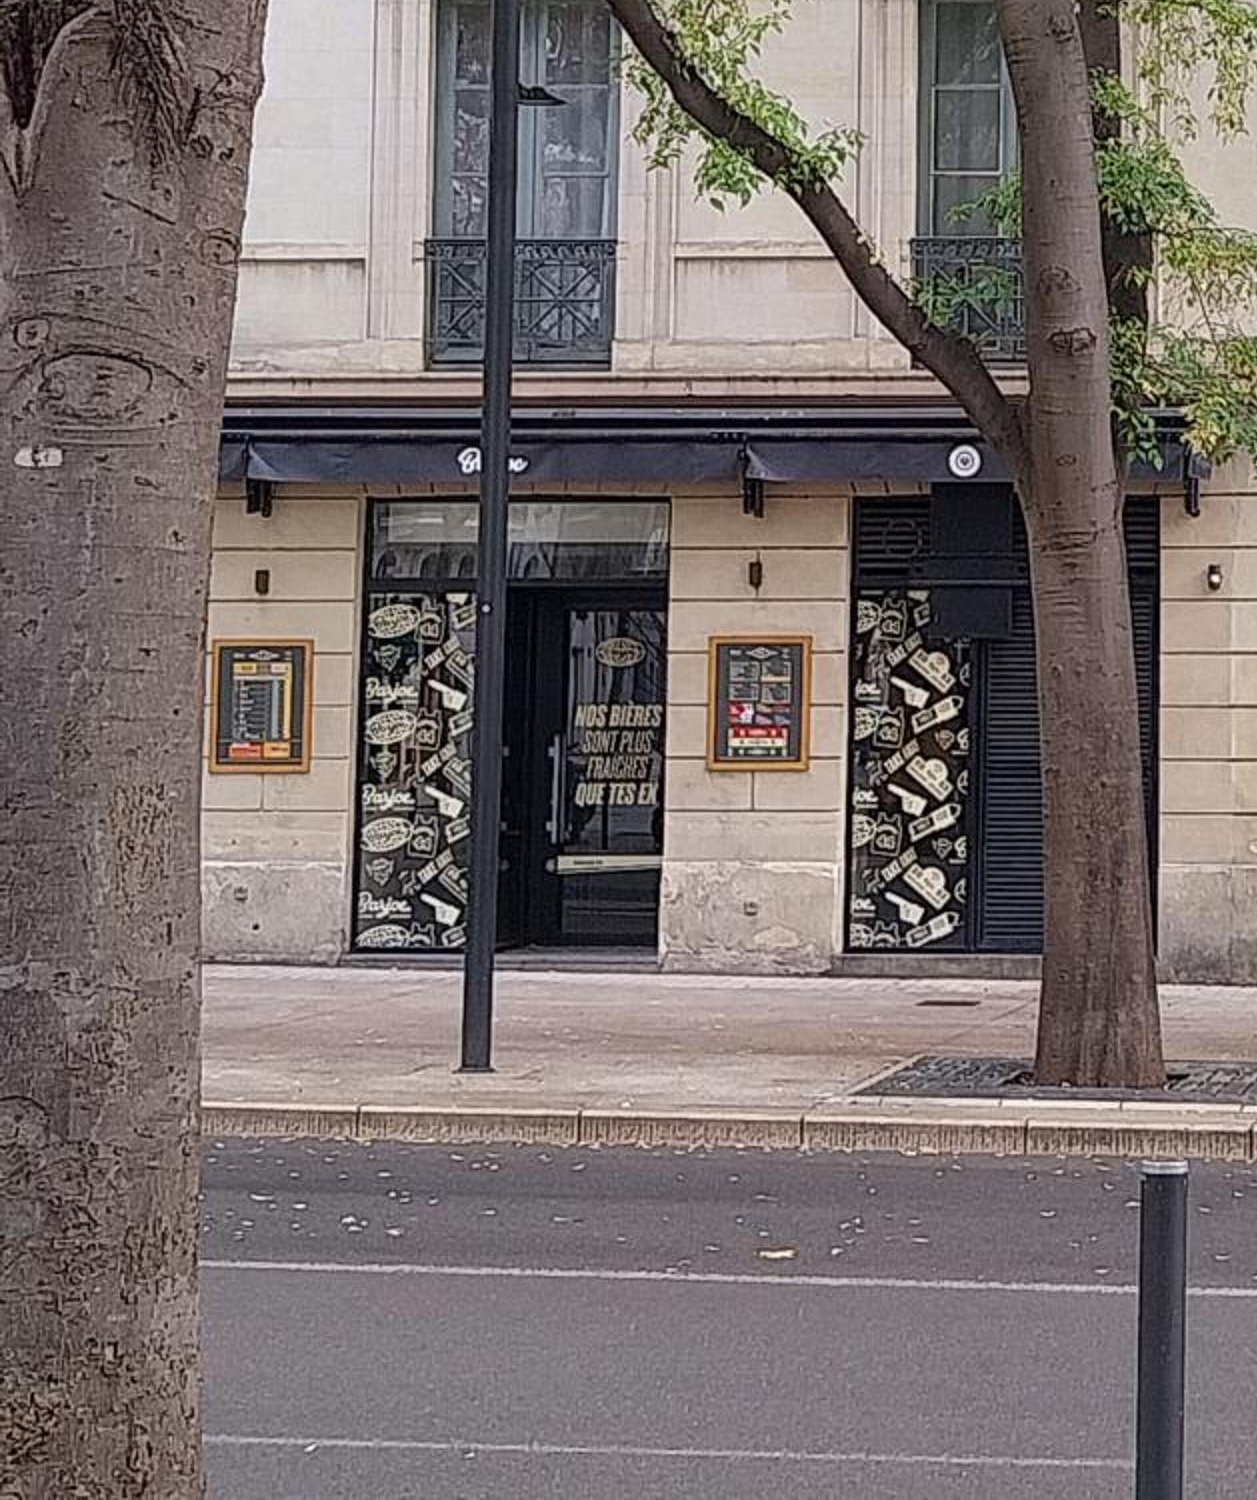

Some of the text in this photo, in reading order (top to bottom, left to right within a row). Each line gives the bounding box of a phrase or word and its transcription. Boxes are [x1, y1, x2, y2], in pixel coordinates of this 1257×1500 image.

[575, 700, 663, 728] NOS BIÈRES
[582, 730, 656, 753] SONT PLUS
[575, 782, 659, 808] QUE TES EX
